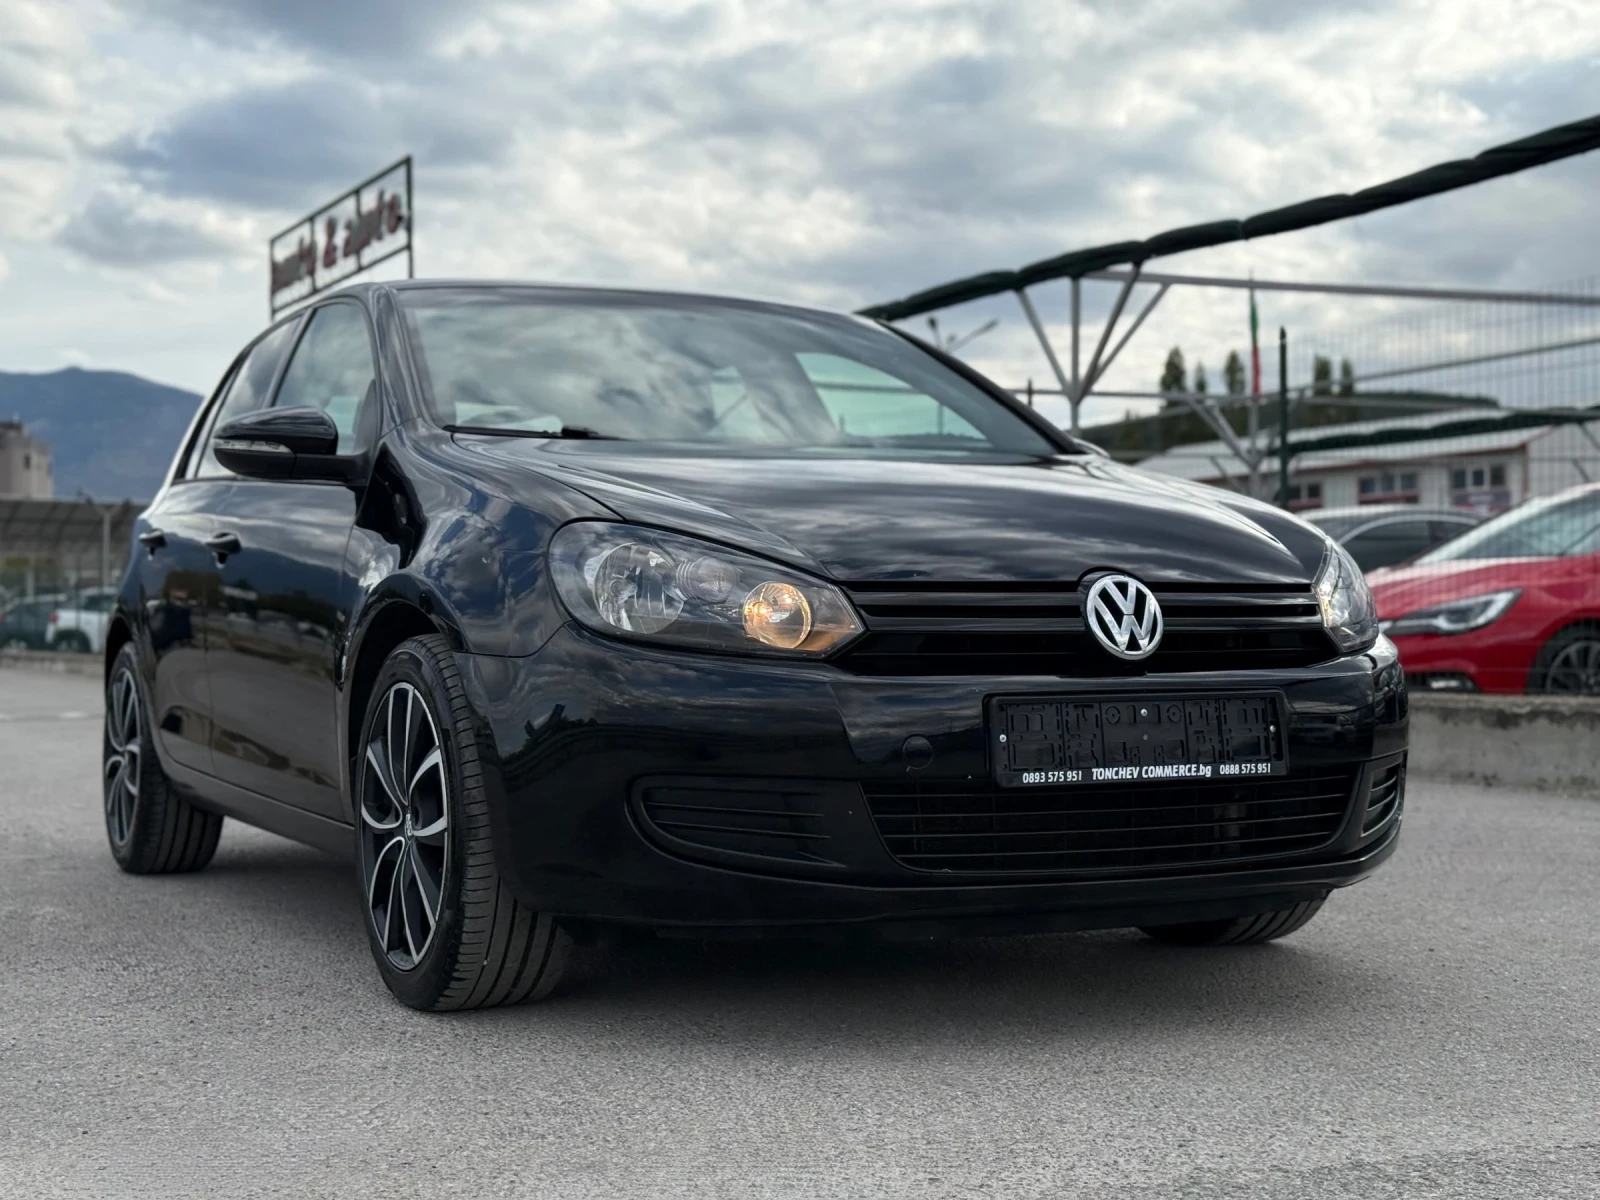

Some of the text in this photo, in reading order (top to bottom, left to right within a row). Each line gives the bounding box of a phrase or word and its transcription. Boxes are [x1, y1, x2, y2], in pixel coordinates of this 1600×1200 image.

[1087, 575, 1163, 658] VW
[1022, 763, 1271, 783] 0893 575 951 TONCHEV COMMERCE.bg 0888 575 951
